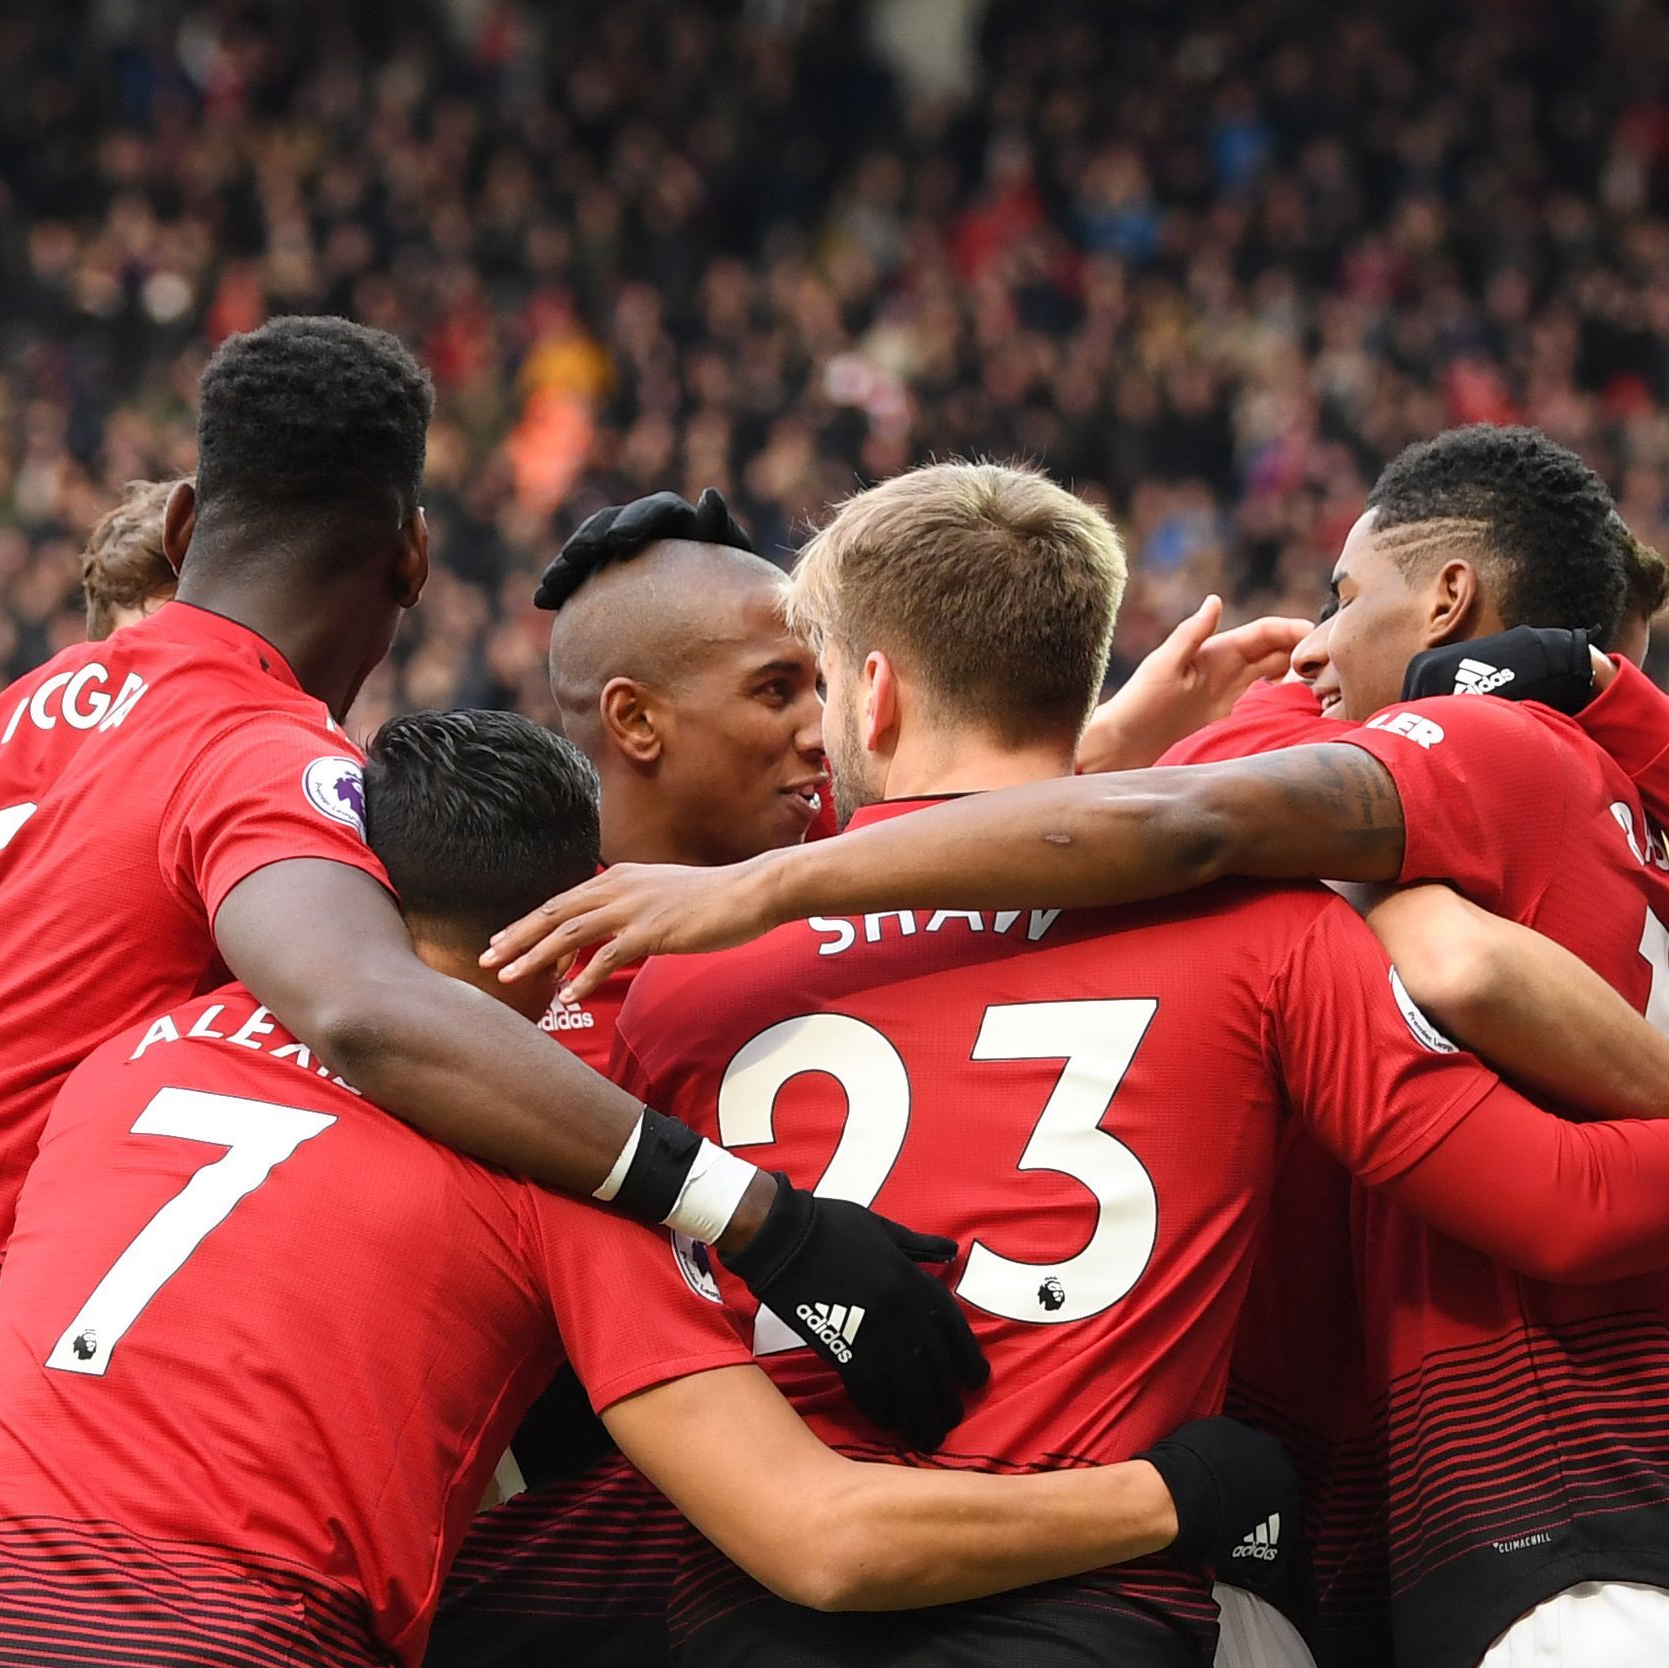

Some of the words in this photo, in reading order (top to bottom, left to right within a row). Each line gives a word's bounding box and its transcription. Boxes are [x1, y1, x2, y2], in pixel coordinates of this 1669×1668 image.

[43, 1085, 341, 1378] 7
[717, 997, 1160, 1324] 23
[795, 1303, 853, 1364] adidas
[1497, 1531, 1552, 1554] CLIMACHILL
